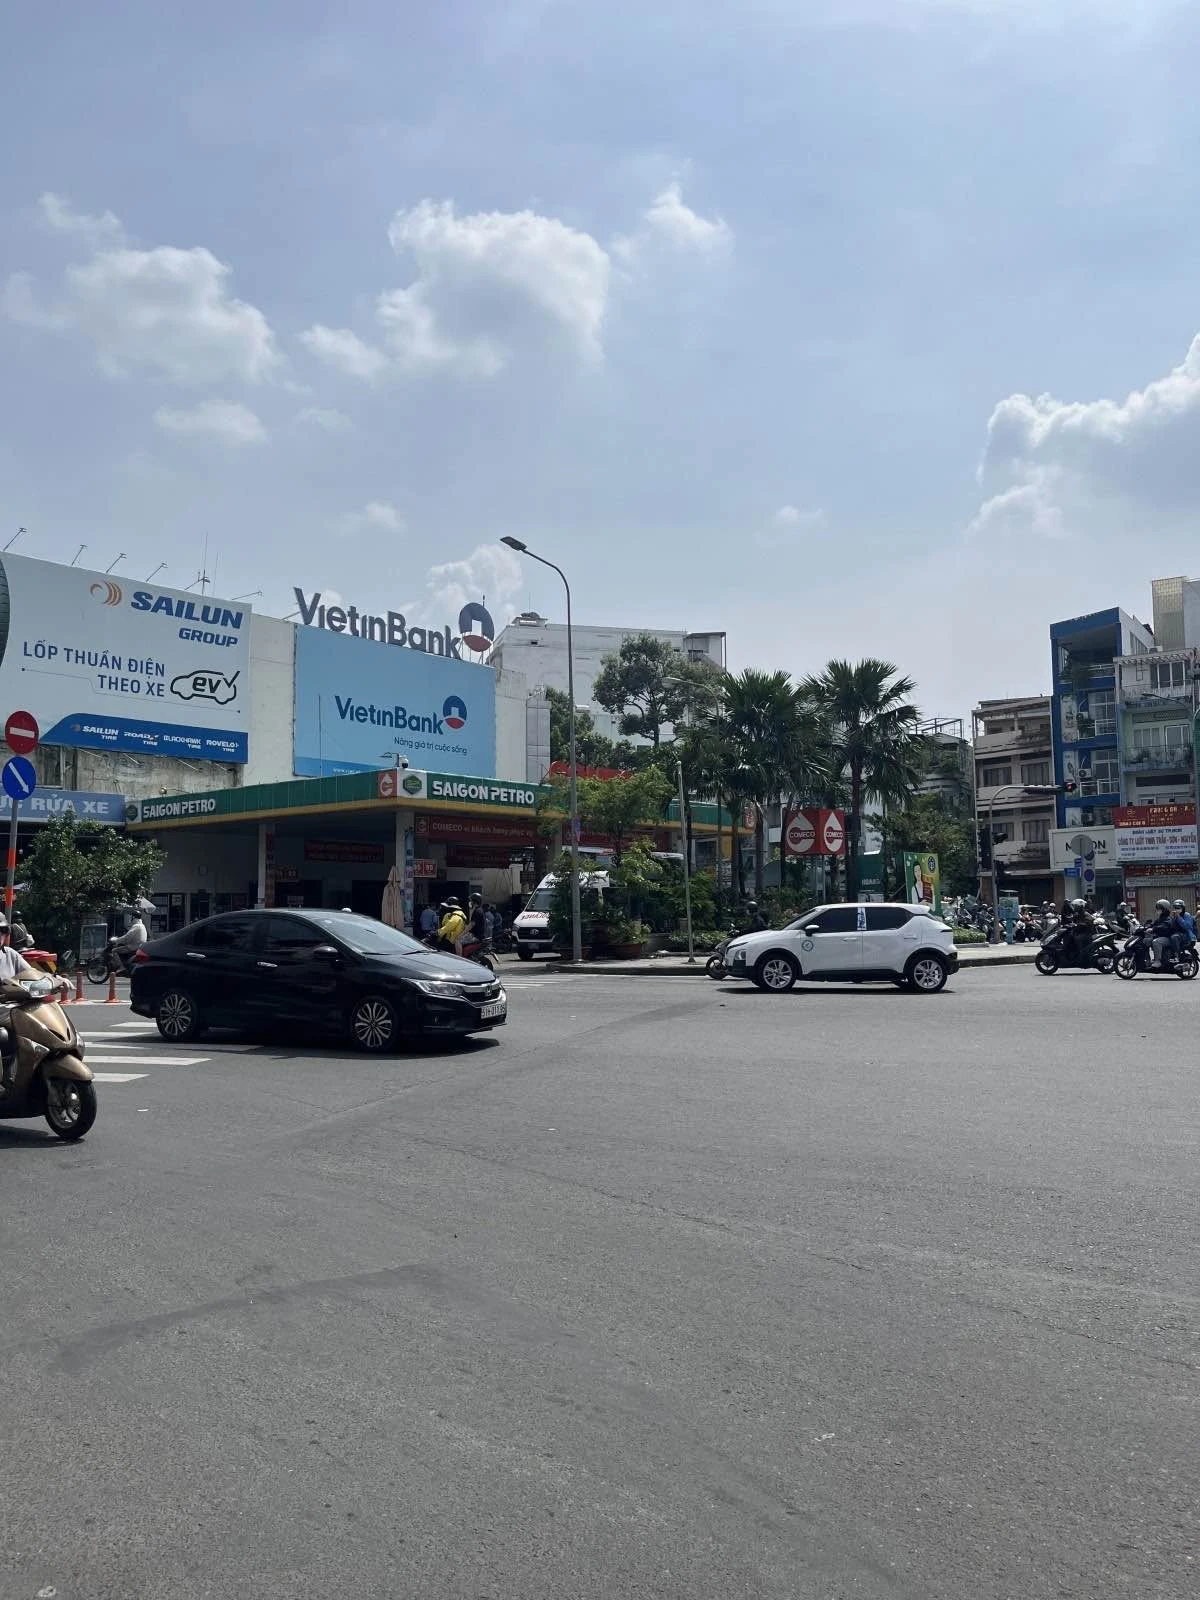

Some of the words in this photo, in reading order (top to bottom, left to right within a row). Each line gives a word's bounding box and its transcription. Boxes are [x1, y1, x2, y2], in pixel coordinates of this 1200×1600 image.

[131, 591, 243, 629] SAILUN
[293, 587, 462, 660] VietinBank
[178, 627, 238, 648] GROUP
[23, 639, 58, 660] LỐP
[64, 647, 122, 671] THUẦN
[128, 656, 165, 678] ĐIỆN
[98, 674, 140, 694] THEO
[146, 681, 165, 697] XE
[335, 695, 444, 735] VietinBank
[82, 725, 119, 736] SAILUN
[82, 801, 110, 814] XE
